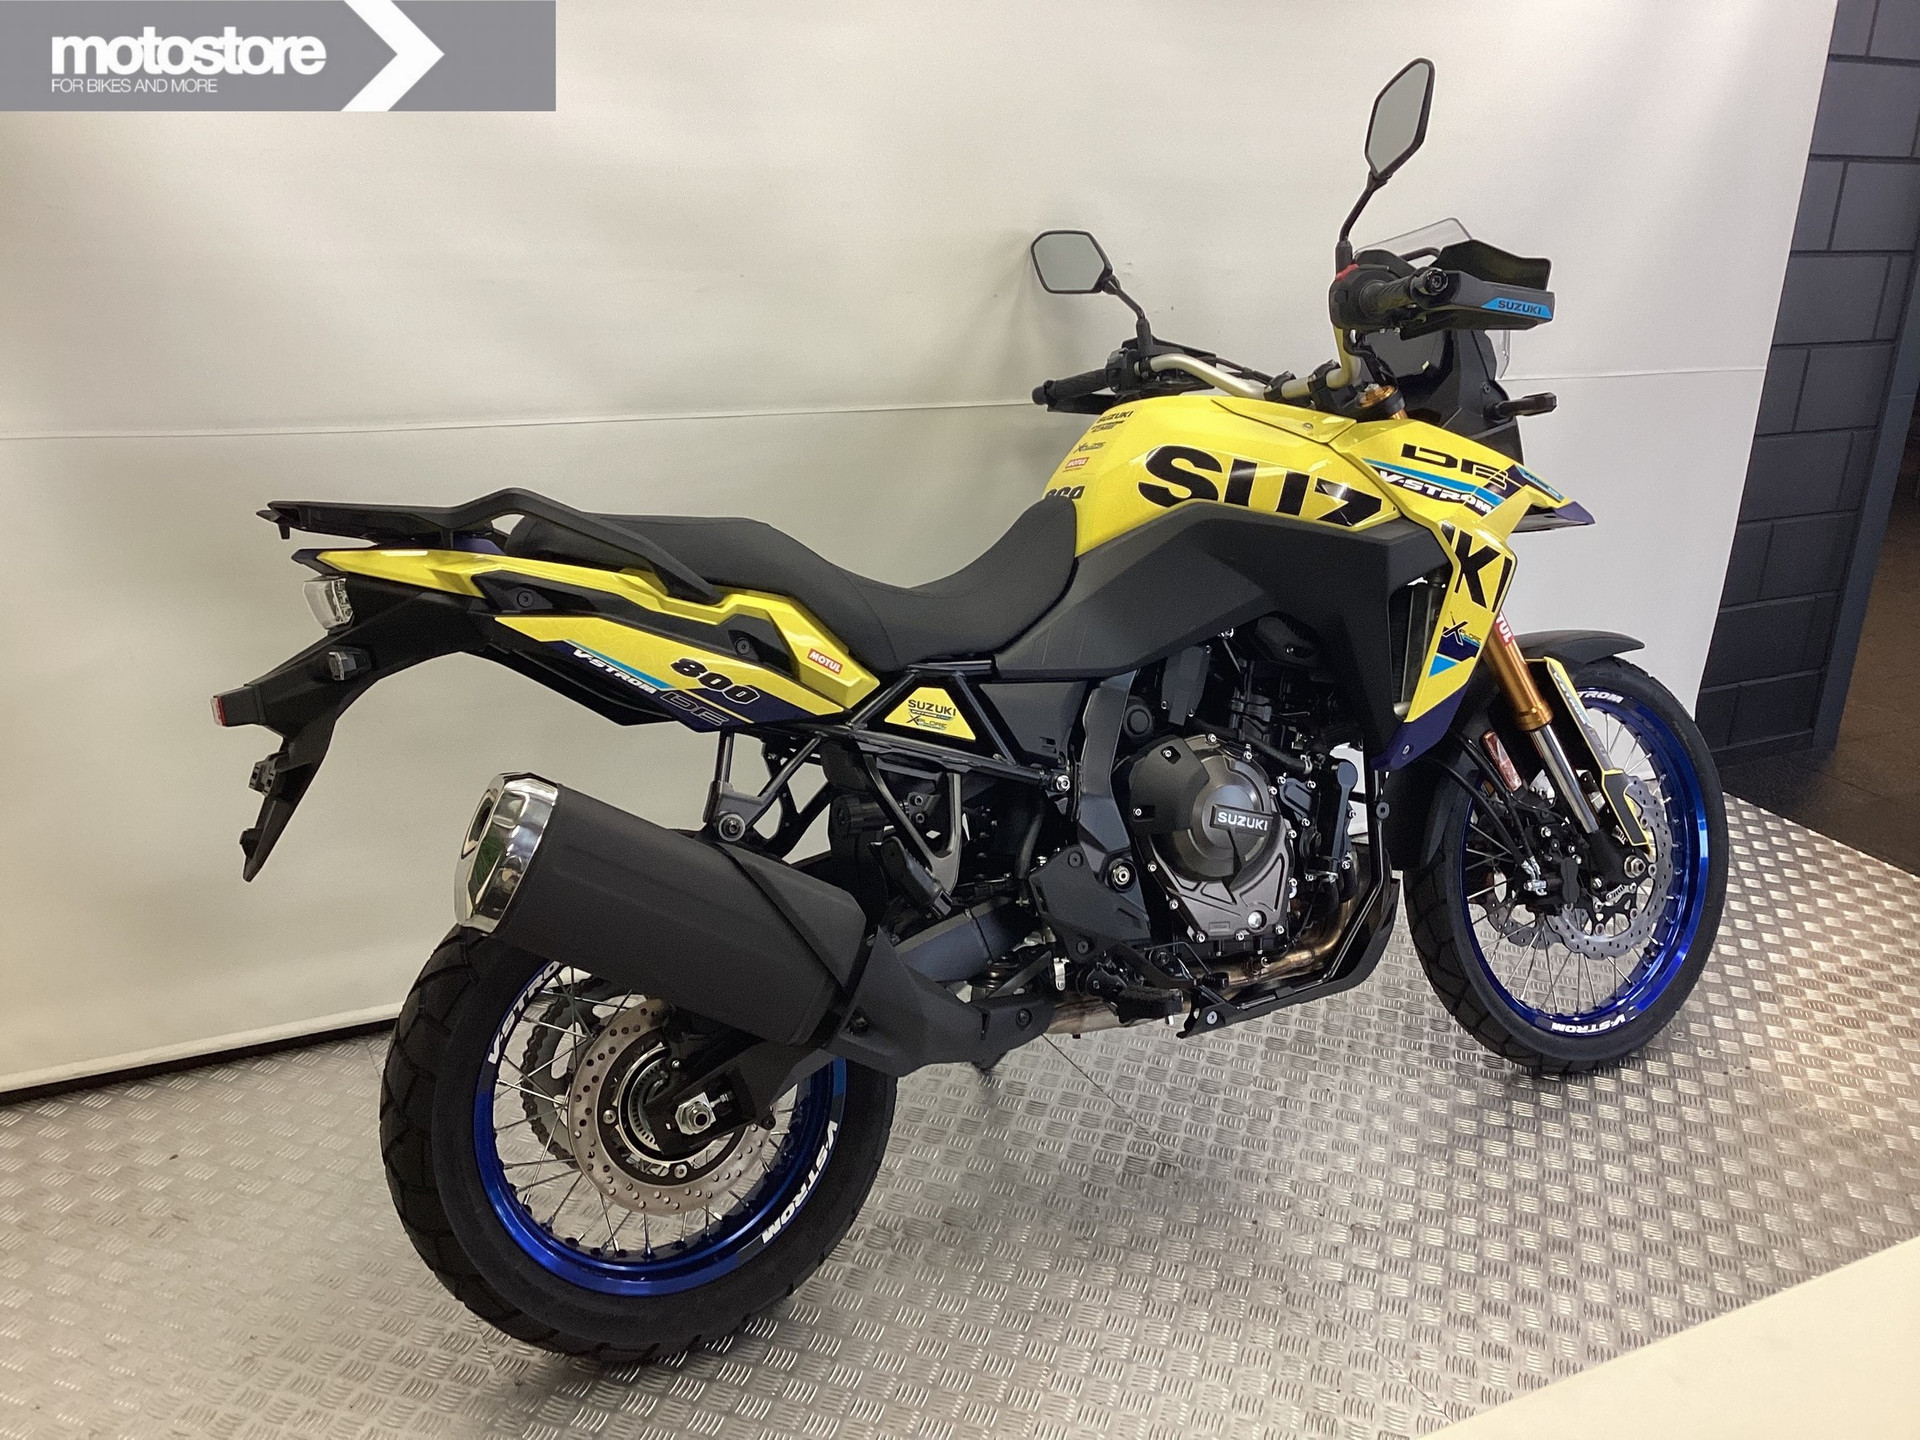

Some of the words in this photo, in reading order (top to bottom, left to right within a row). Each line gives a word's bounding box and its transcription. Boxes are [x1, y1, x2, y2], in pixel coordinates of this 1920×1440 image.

[1498, 300, 1541, 315] SUZUKI
[1496, 611, 1513, 643] TUL
[573, 648, 657, 694] V-STROM
[810, 651, 841, 673] MOTUL
[670, 657, 761, 705] 800
[907, 699, 956, 716] SUZUKI
[1577, 690, 1624, 703] TROM
[1218, 812, 1267, 831] SUZUKI
[488, 961, 562, 1064] V-STRO
